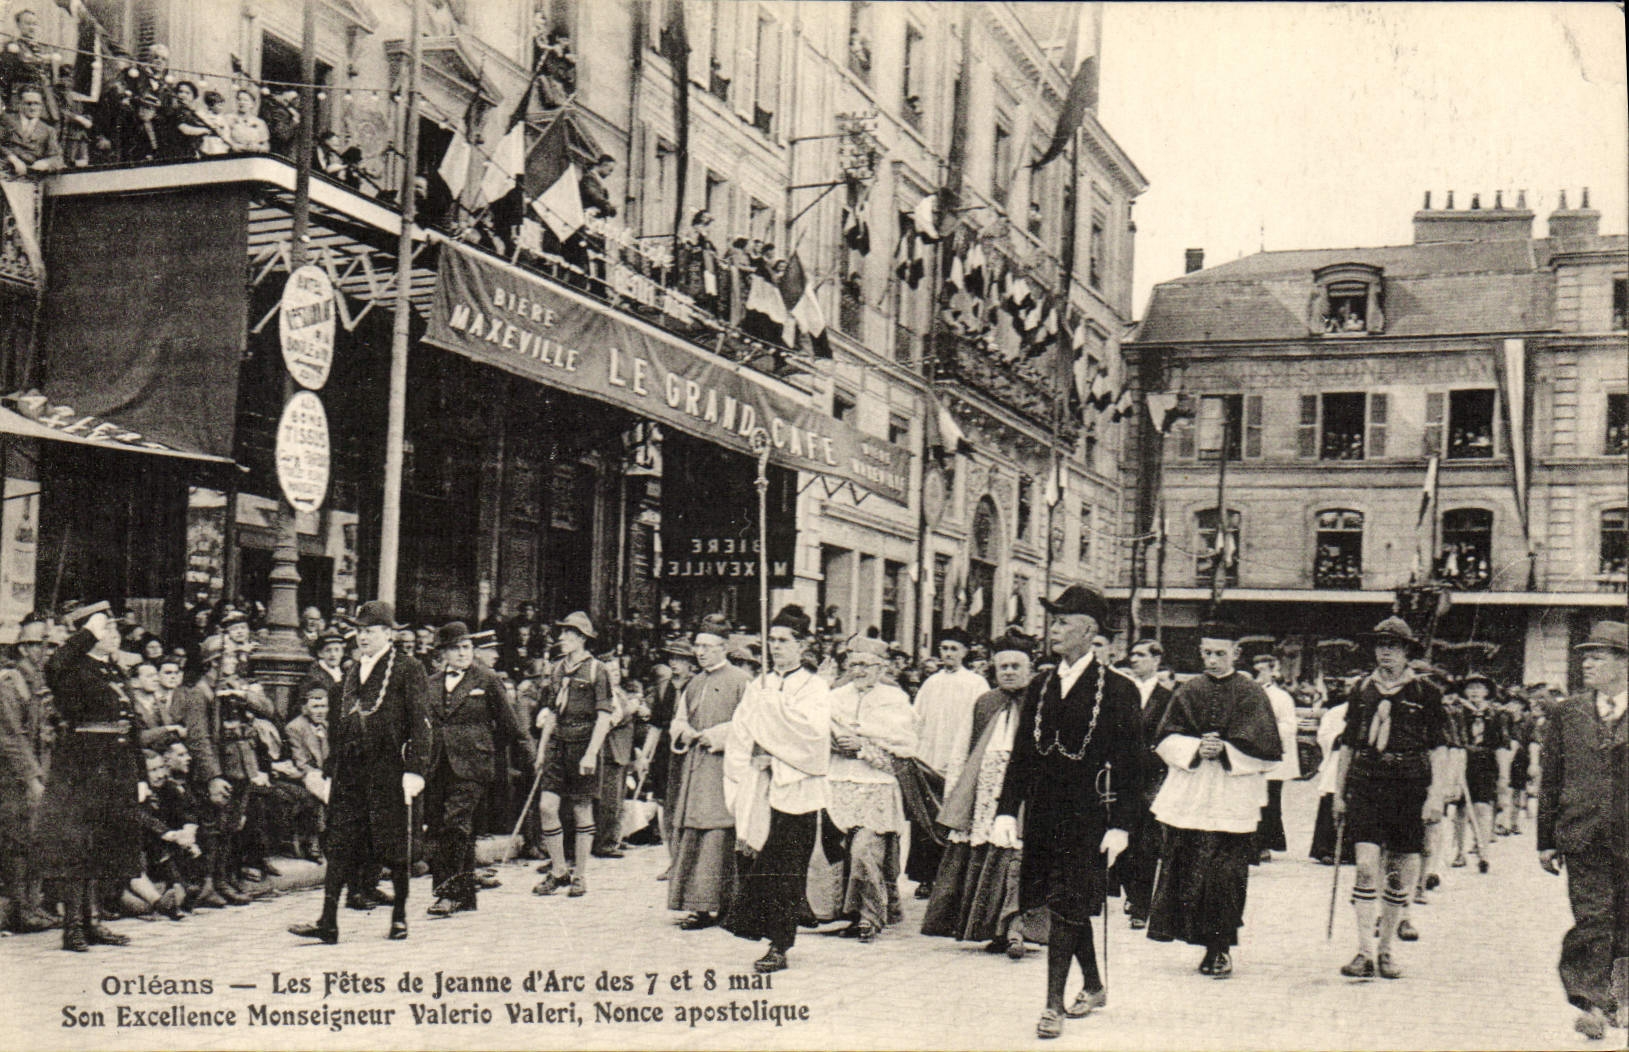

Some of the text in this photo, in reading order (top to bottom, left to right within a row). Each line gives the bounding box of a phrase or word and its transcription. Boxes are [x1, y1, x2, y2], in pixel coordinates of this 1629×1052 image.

[449, 304, 579, 372] MAXEVILLE
[493, 288, 556, 327] BIERE
[608, 348, 648, 395] LE
[666, 372, 756, 437] GRAND
[772, 417, 837, 466] CAFE
